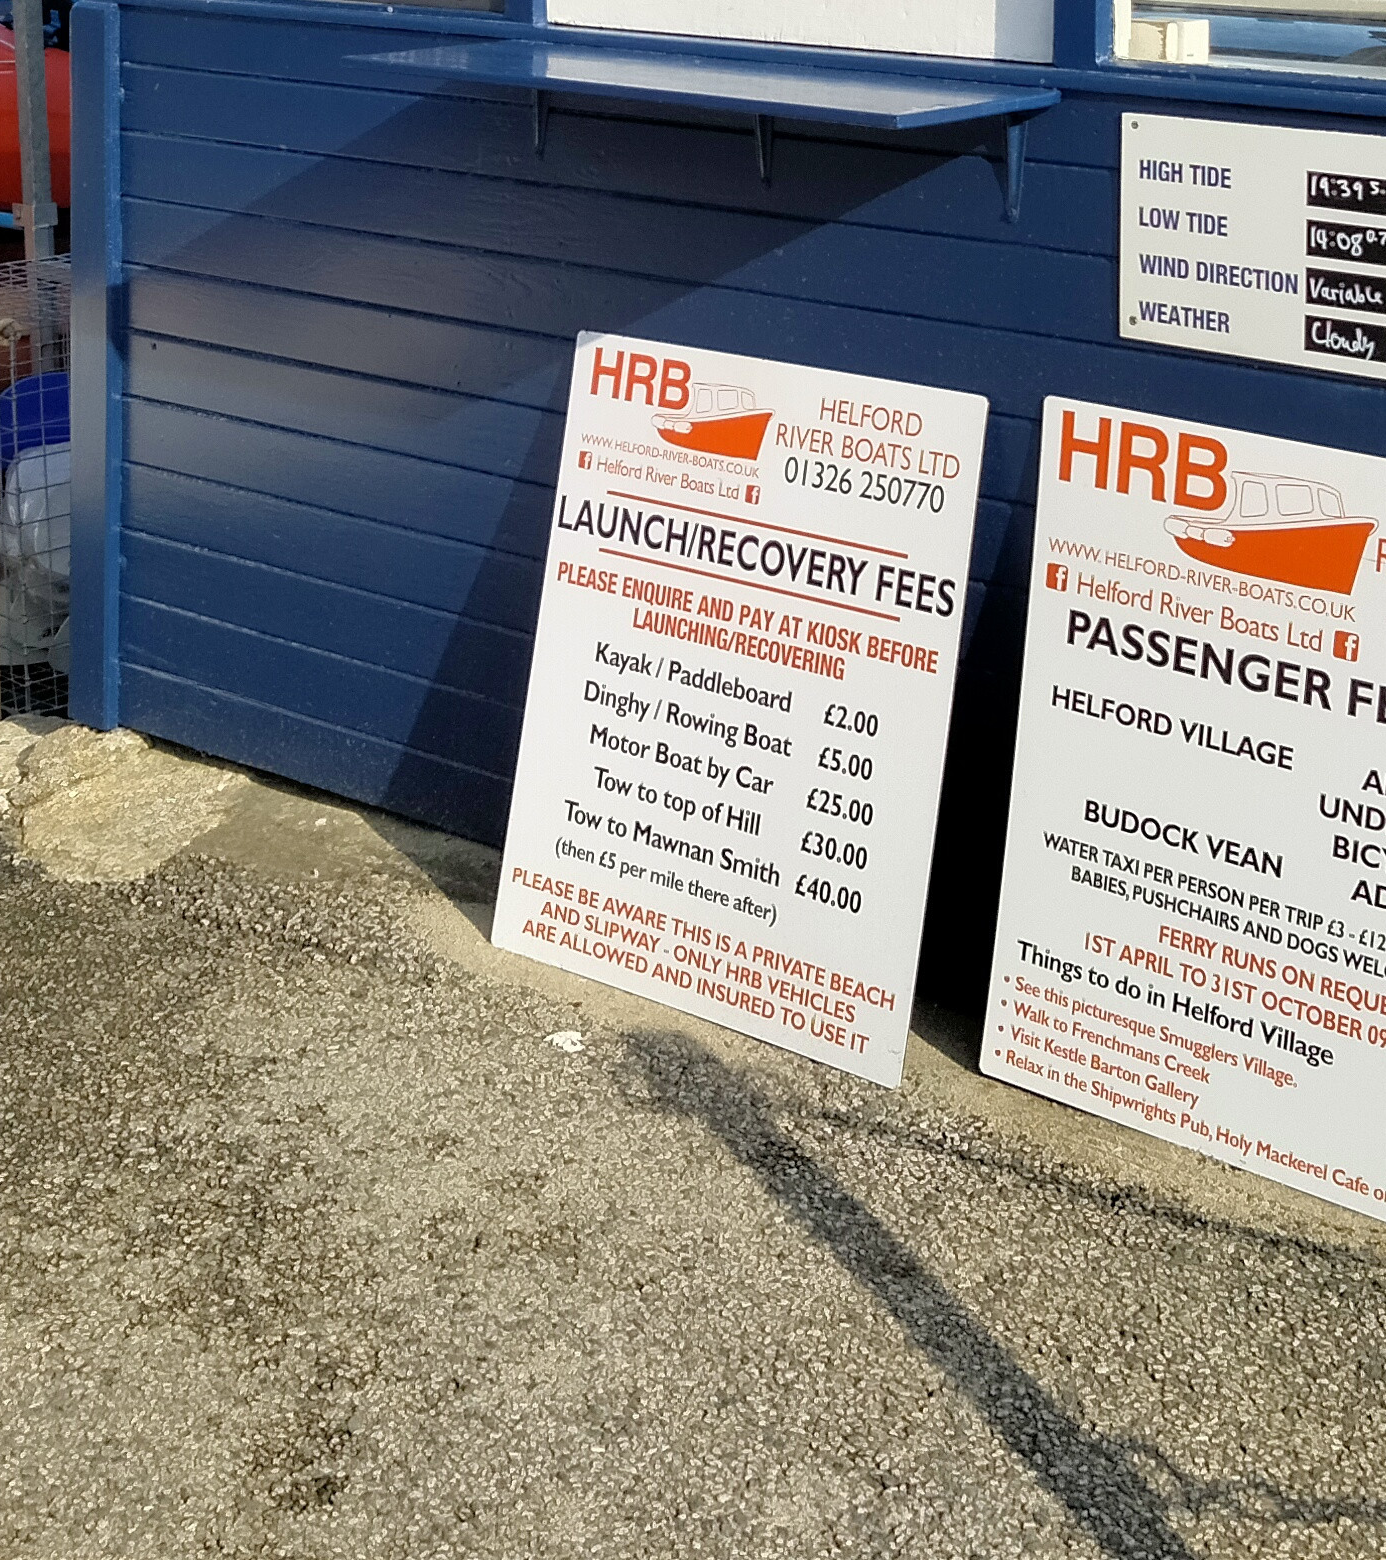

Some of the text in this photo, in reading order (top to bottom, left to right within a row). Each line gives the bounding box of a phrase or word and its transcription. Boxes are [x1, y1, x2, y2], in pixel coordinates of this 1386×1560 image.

[1139, 158, 1232, 190] HIGH TIDE
[1139, 206, 1229, 238] LOW TIDE
[1139, 252, 1299, 296] WIND DIRECTION
[1309, 276, 1384, 306] Variable
[1139, 300, 1230, 335] WEATHER
[1312, 321, 1376, 360] Cloudy
[590, 347, 691, 410] HRB
[820, 398, 922, 436] HELFORD
[776, 423, 960, 479] RIVER BOATS LTD
[785, 457, 944, 513] 01326 250770
[1059, 410, 1227, 511] HRB
[558, 495, 955, 617] LAUNCH/RECOVERY FEES
[1048, 537, 1356, 622] WWW.HELFORD-RIVER-BOATS.CO.UK
[557, 562, 939, 674] PLEASE ENQUIRE AND PAY AT KIOSK BEFORE
[633, 608, 845, 680] LAUNCHING/RECOVERING
[595, 642, 652, 676] Kayak
[668, 660, 792, 713] Paddleboard
[823, 704, 878, 737] £2.00
[1067, 609, 1331, 711] PASSENGER
[584, 680, 651, 722] Dinghy
[666, 702, 739, 748] Rowing
[743, 723, 792, 757] Boat
[818, 747, 872, 780] £5.00
[1052, 685, 1294, 771] HELFORD VILLAGE
[1084, 799, 1199, 854] BUDOCK
[1206, 834, 1283, 878] VEAN
[556, 837, 777, 927] (then £5 per mile there after)
[1011, 1024, 1199, 1110] Visit Kestle Barton Gallery
[1013, 999, 1210, 1084] Walk to Frenchmans Creek
